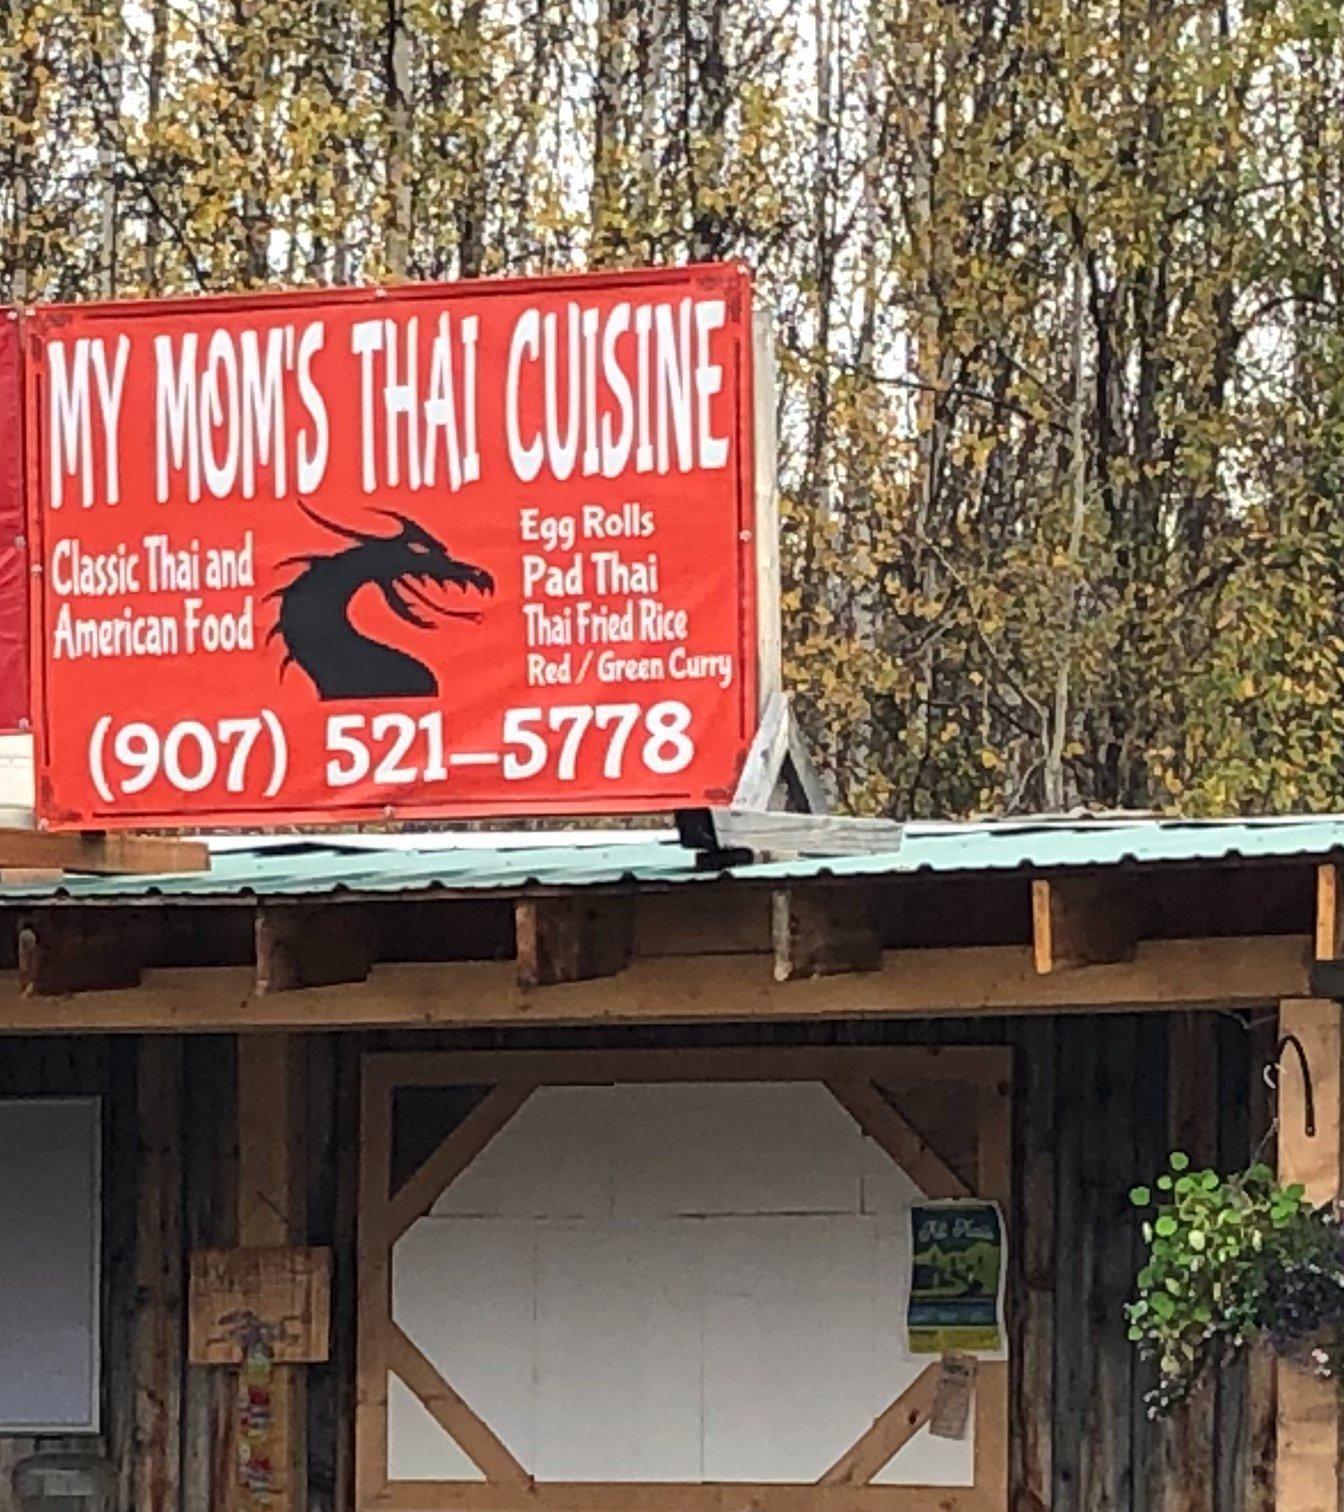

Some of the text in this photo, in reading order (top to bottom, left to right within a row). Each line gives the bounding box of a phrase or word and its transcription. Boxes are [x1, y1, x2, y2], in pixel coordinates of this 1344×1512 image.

[47, 297, 731, 508] MY MOM'S THAI CUISINE
[518, 504, 656, 549] Egg Rolls
[52, 530, 255, 598] Classic Thai and
[521, 552, 658, 598] Pad Thai
[52, 597, 255, 660] American Food
[524, 600, 688, 646] Thai Fried Rice
[526, 646, 735, 689] Red / Green Curry
[87, 699, 696, 802] (907) 521-5778
